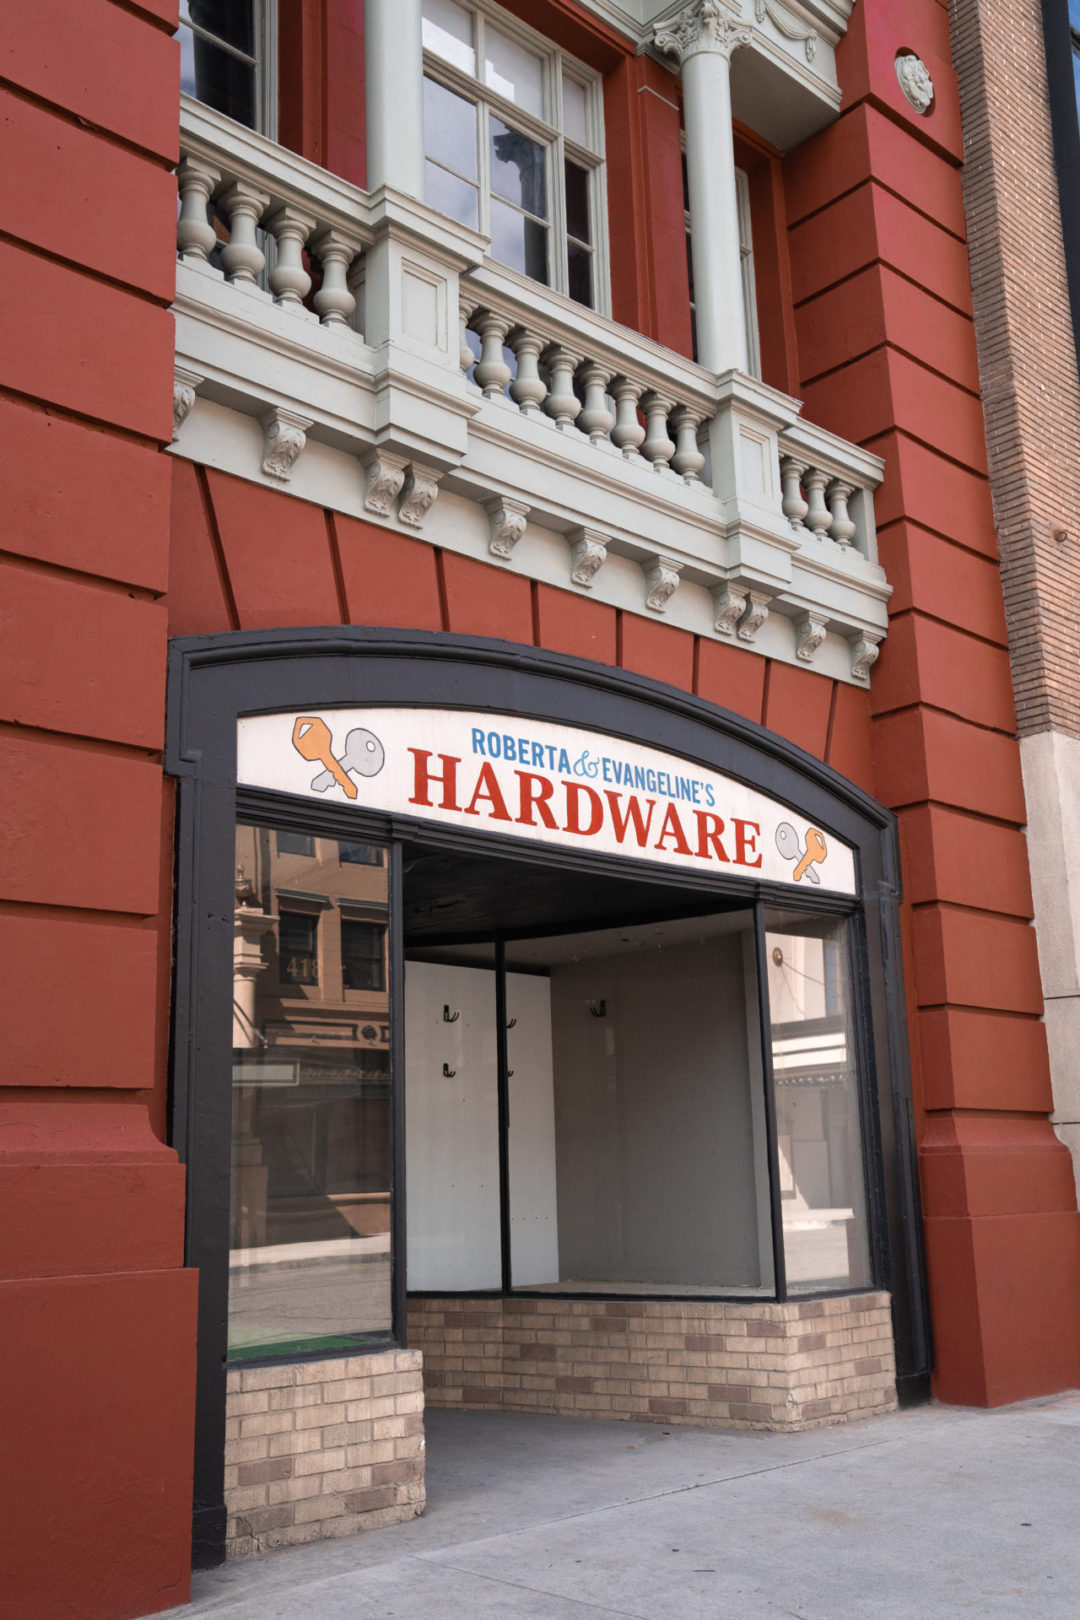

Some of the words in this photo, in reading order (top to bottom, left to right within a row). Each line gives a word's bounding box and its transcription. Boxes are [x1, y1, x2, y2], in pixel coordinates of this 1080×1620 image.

[407, 747, 763, 869] HARDWARE
[472, 728, 572, 775] ROBERTA
[573, 750, 600, 779] &
[602, 757, 715, 808] EVANGELINE'S
